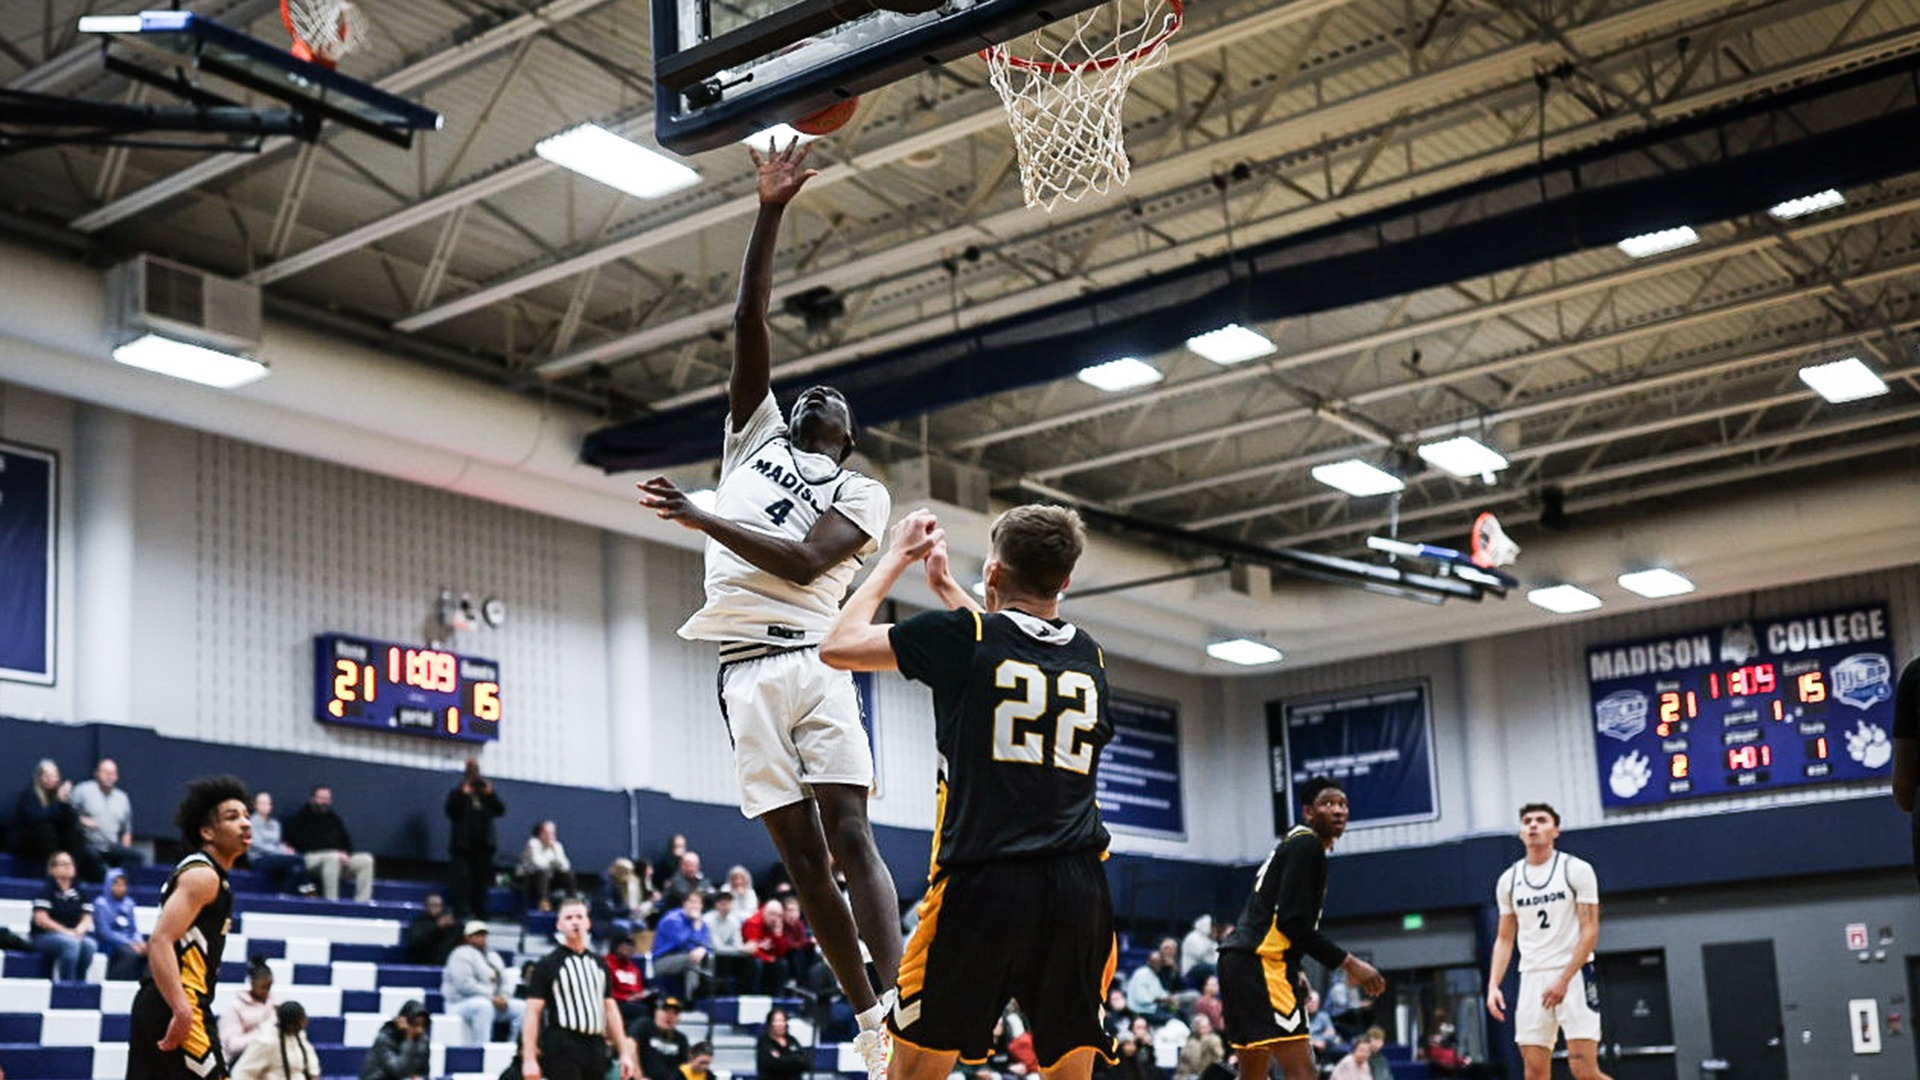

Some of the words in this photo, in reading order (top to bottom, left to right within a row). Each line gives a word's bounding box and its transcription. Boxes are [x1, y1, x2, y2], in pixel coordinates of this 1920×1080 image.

[765, 498, 795, 527] 4
[1591, 637, 1712, 681] MADISON
[1767, 610, 1885, 655] COLLEGE
[334, 659, 376, 702] 21
[1798, 672, 1826, 703] 15
[446, 705, 460, 735] 1
[993, 658, 1098, 775] 22
[1660, 690, 1698, 724] 21
[1771, 699, 1783, 721] 1
[1816, 737, 1828, 759] 1
[1671, 753, 1688, 778] 2
[1516, 891, 1566, 907] MADISON
[1537, 909, 1550, 929] 2
